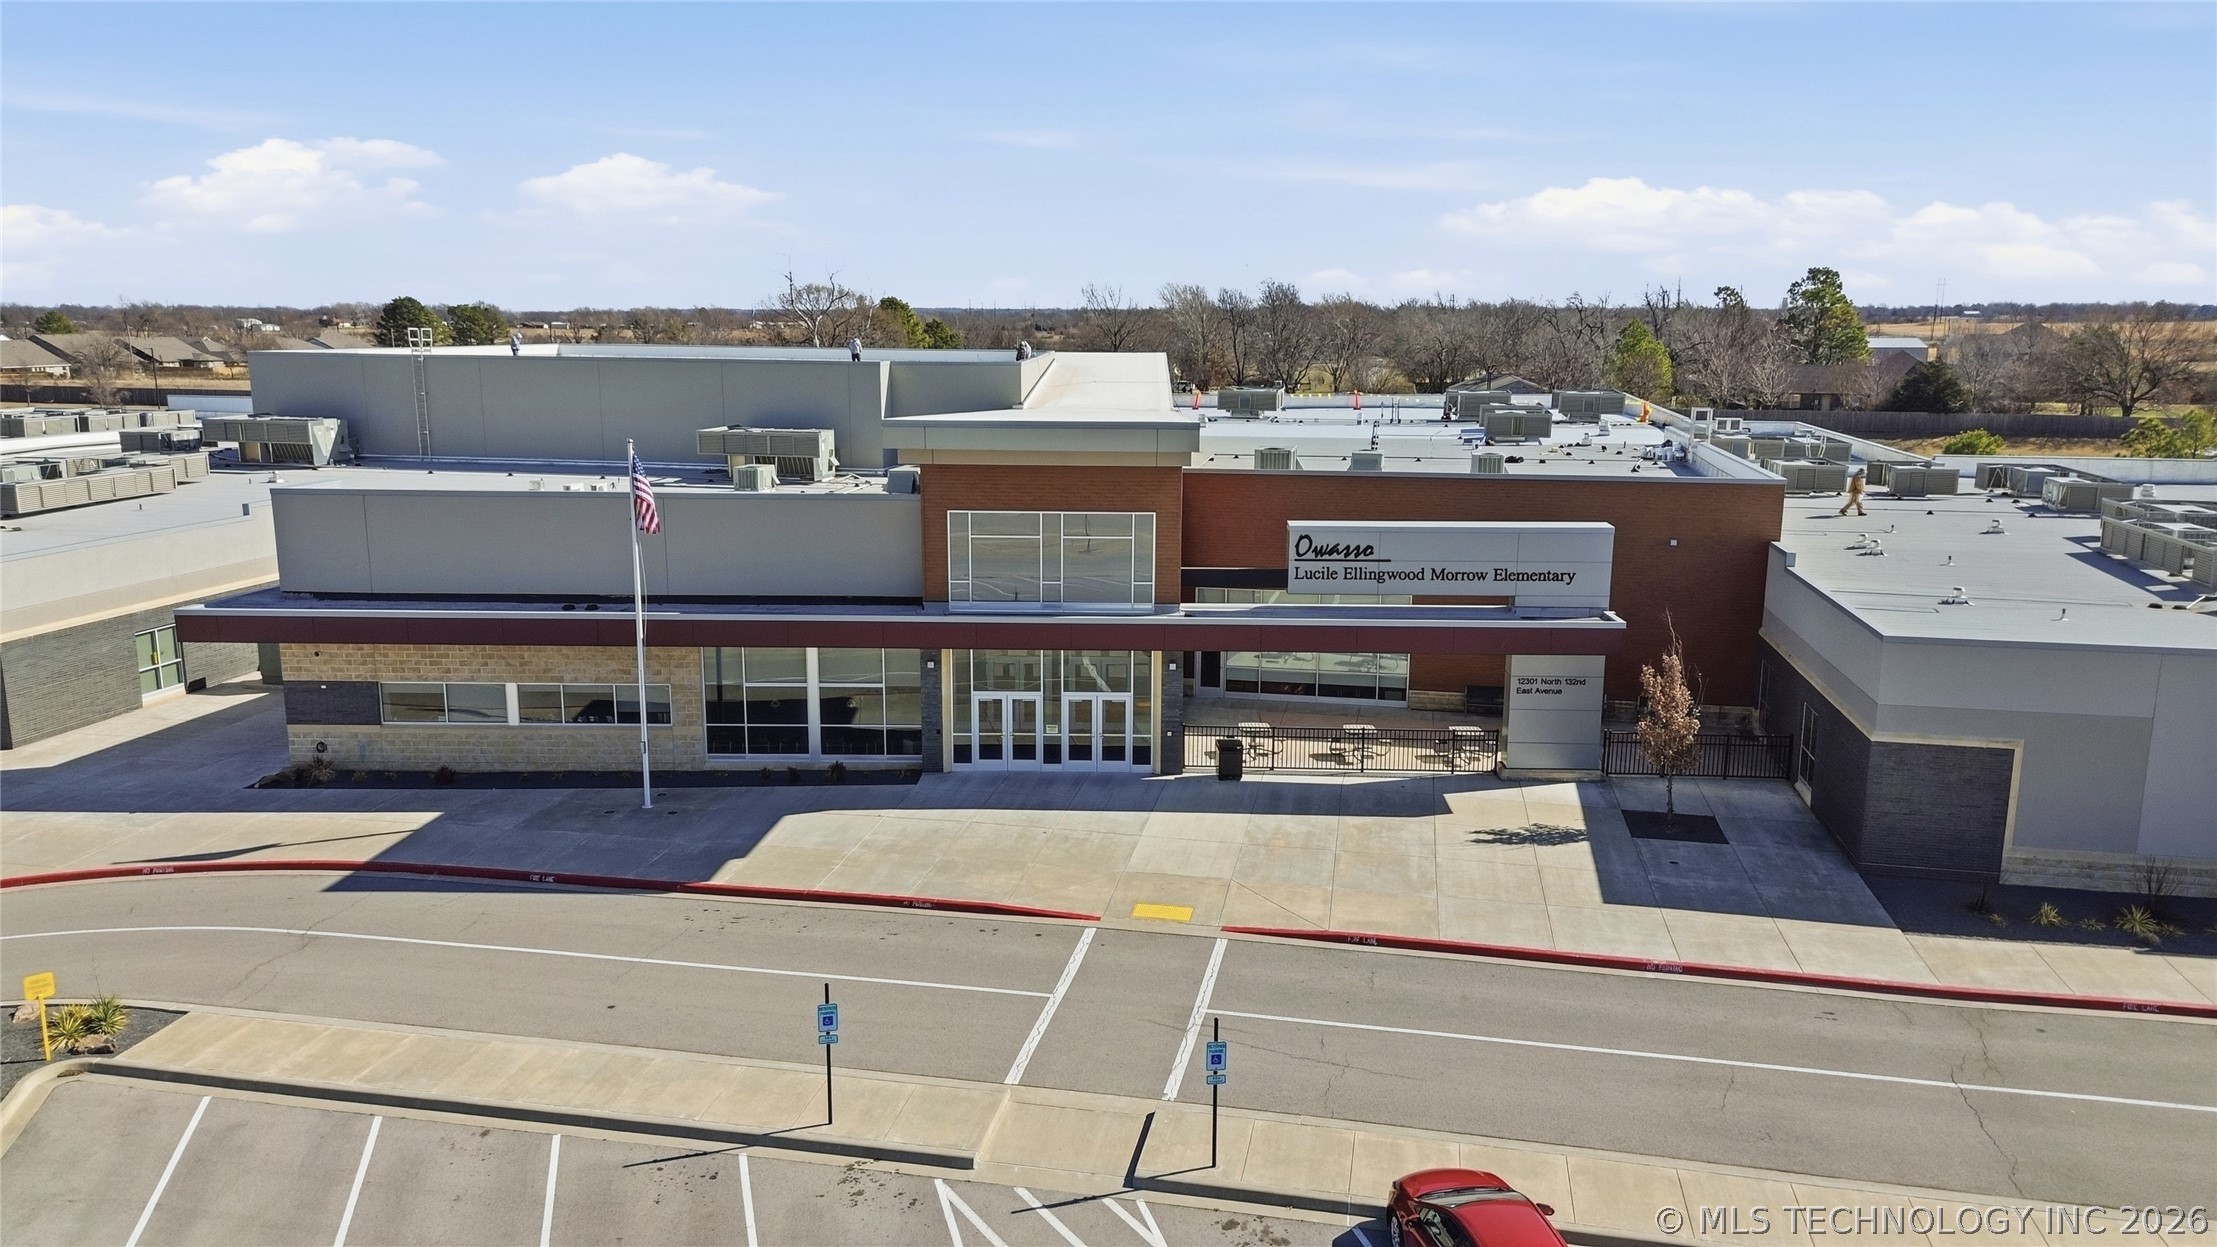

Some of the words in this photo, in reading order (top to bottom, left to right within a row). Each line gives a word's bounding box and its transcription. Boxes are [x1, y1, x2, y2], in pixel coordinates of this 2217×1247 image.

[1294, 534, 1375, 558] Owasso
[1294, 566, 1339, 580] Lucile
[1343, 566, 1425, 584] Ellingwood
[1431, 567, 1488, 581] Morrow
[1492, 568, 1576, 585] Elementary
[1517, 677, 1538, 685] 12301
[1565, 678, 1586, 686] 132nd
[1534, 687, 1563, 695] Avenue
